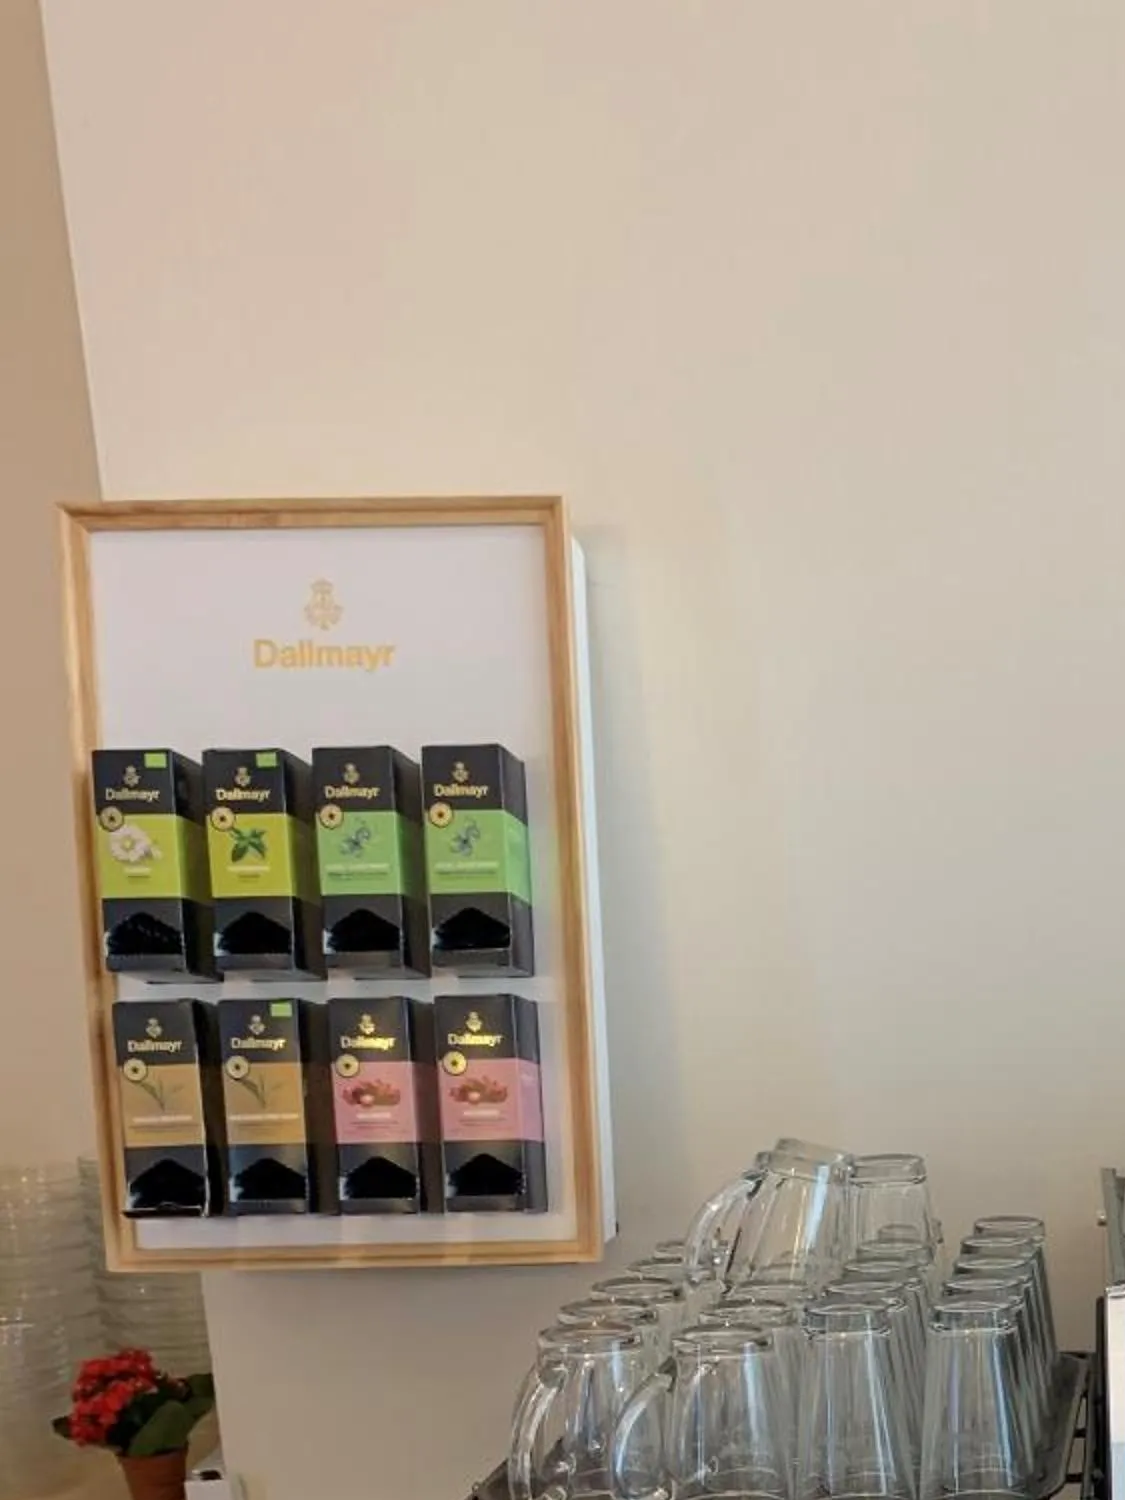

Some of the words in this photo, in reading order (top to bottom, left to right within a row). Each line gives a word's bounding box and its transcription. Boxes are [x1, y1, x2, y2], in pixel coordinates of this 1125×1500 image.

[253, 637, 396, 674] Dallmayr
[105, 787, 160, 801] Dallmayr
[215, 788, 271, 801] Dallmayr
[324, 784, 380, 800] Dallmayr
[433, 783, 489, 798] Dallmayr
[127, 1039, 182, 1052] Dallmayr
[231, 1036, 287, 1051] Dallmayr
[340, 1034, 397, 1050] Dallmayr
[447, 1033, 503, 1047] Dallmayr
